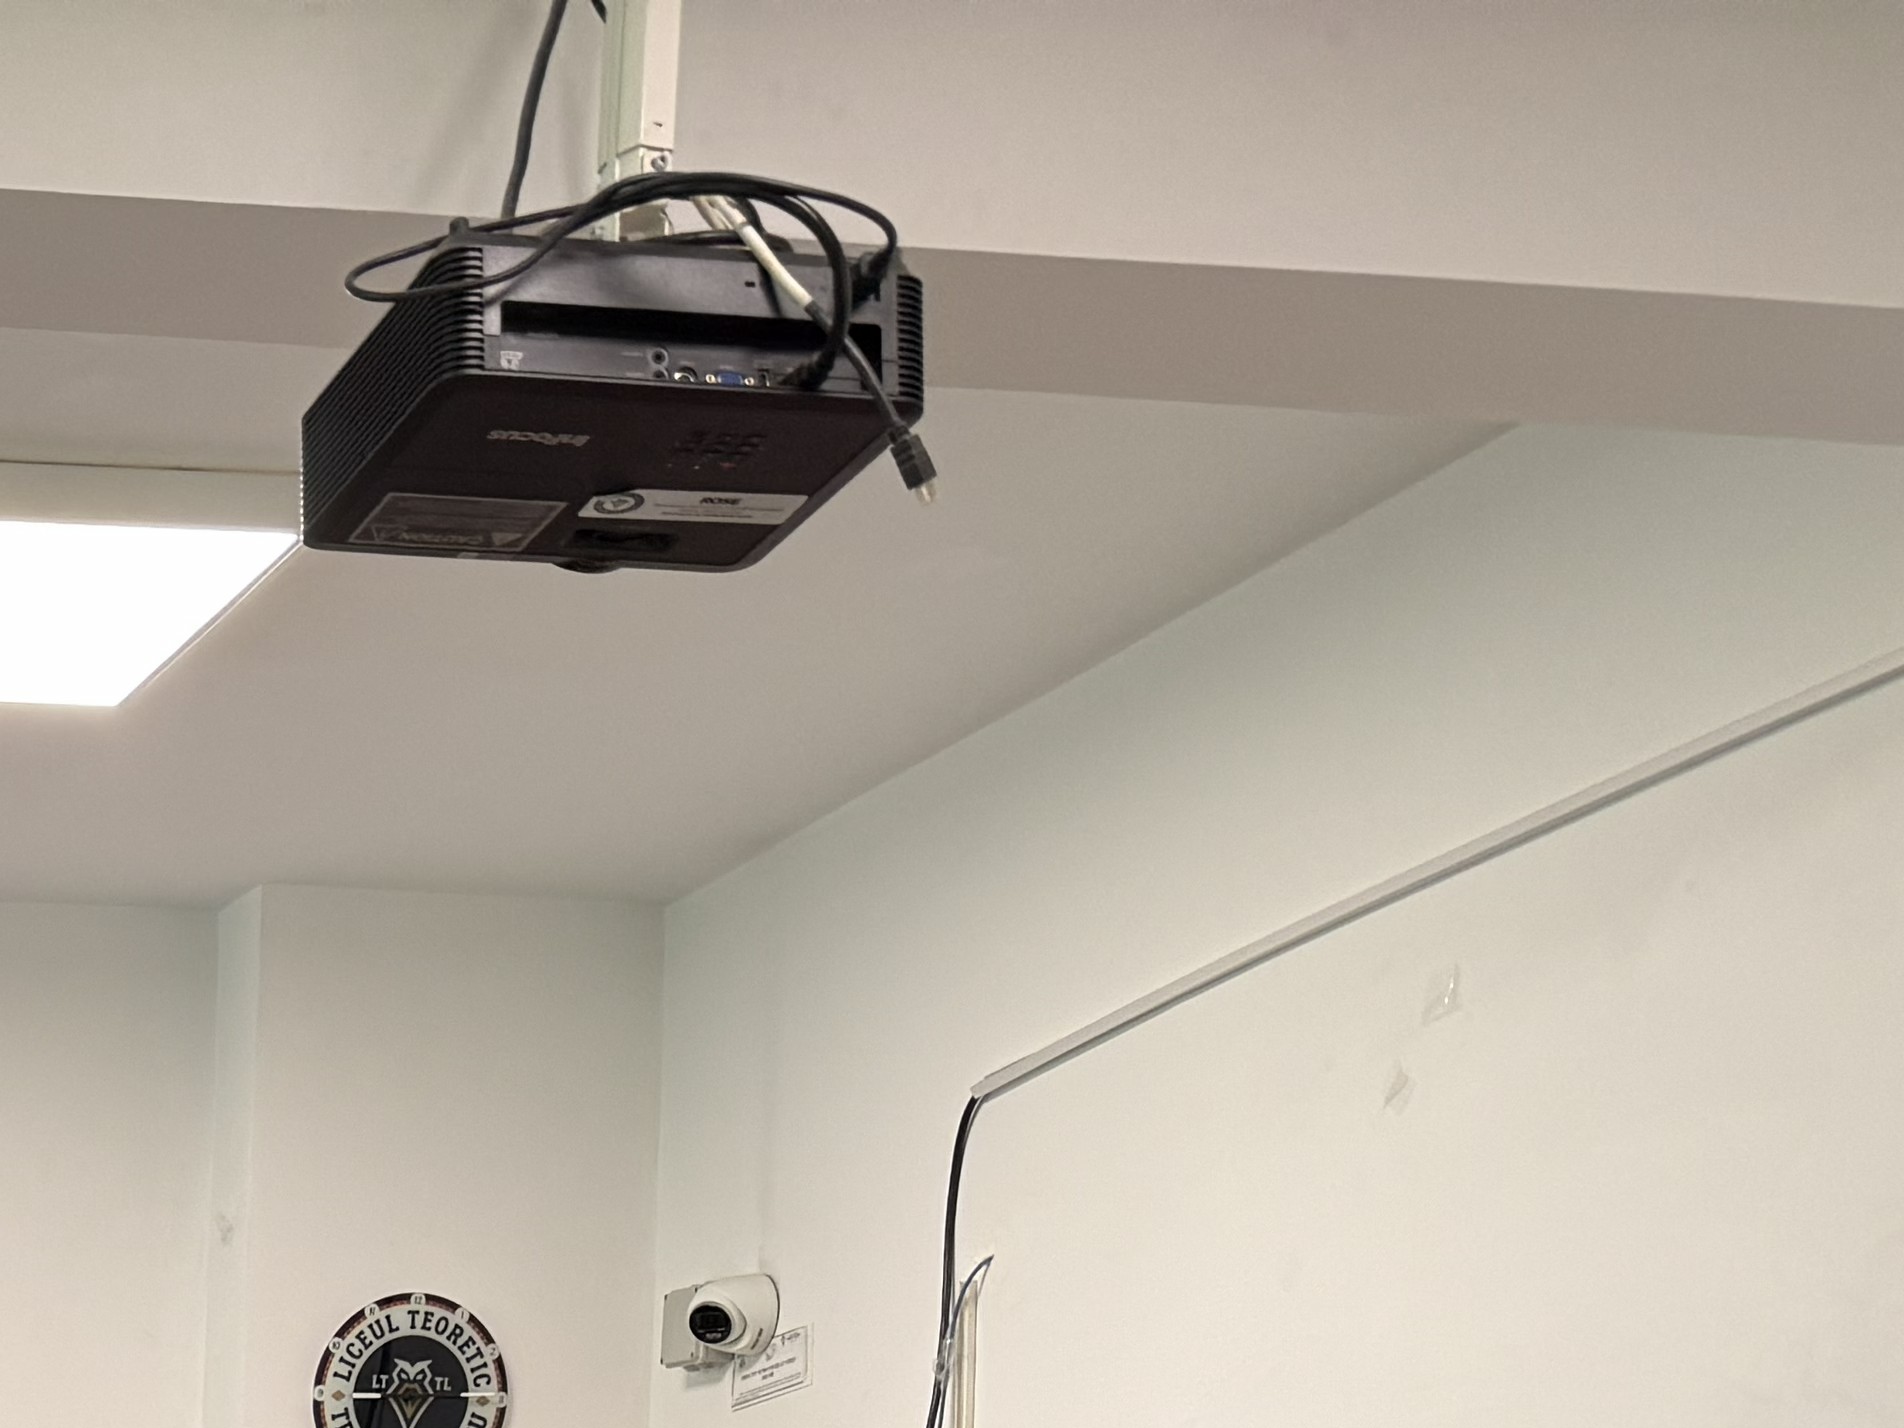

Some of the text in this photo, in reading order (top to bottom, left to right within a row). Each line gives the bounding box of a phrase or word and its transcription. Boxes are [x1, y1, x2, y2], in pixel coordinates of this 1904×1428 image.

[333, 1309, 492, 1388] LICEUL TEORETIC
[371, 1374, 389, 1389] LT
[434, 1377, 452, 1391] TL
